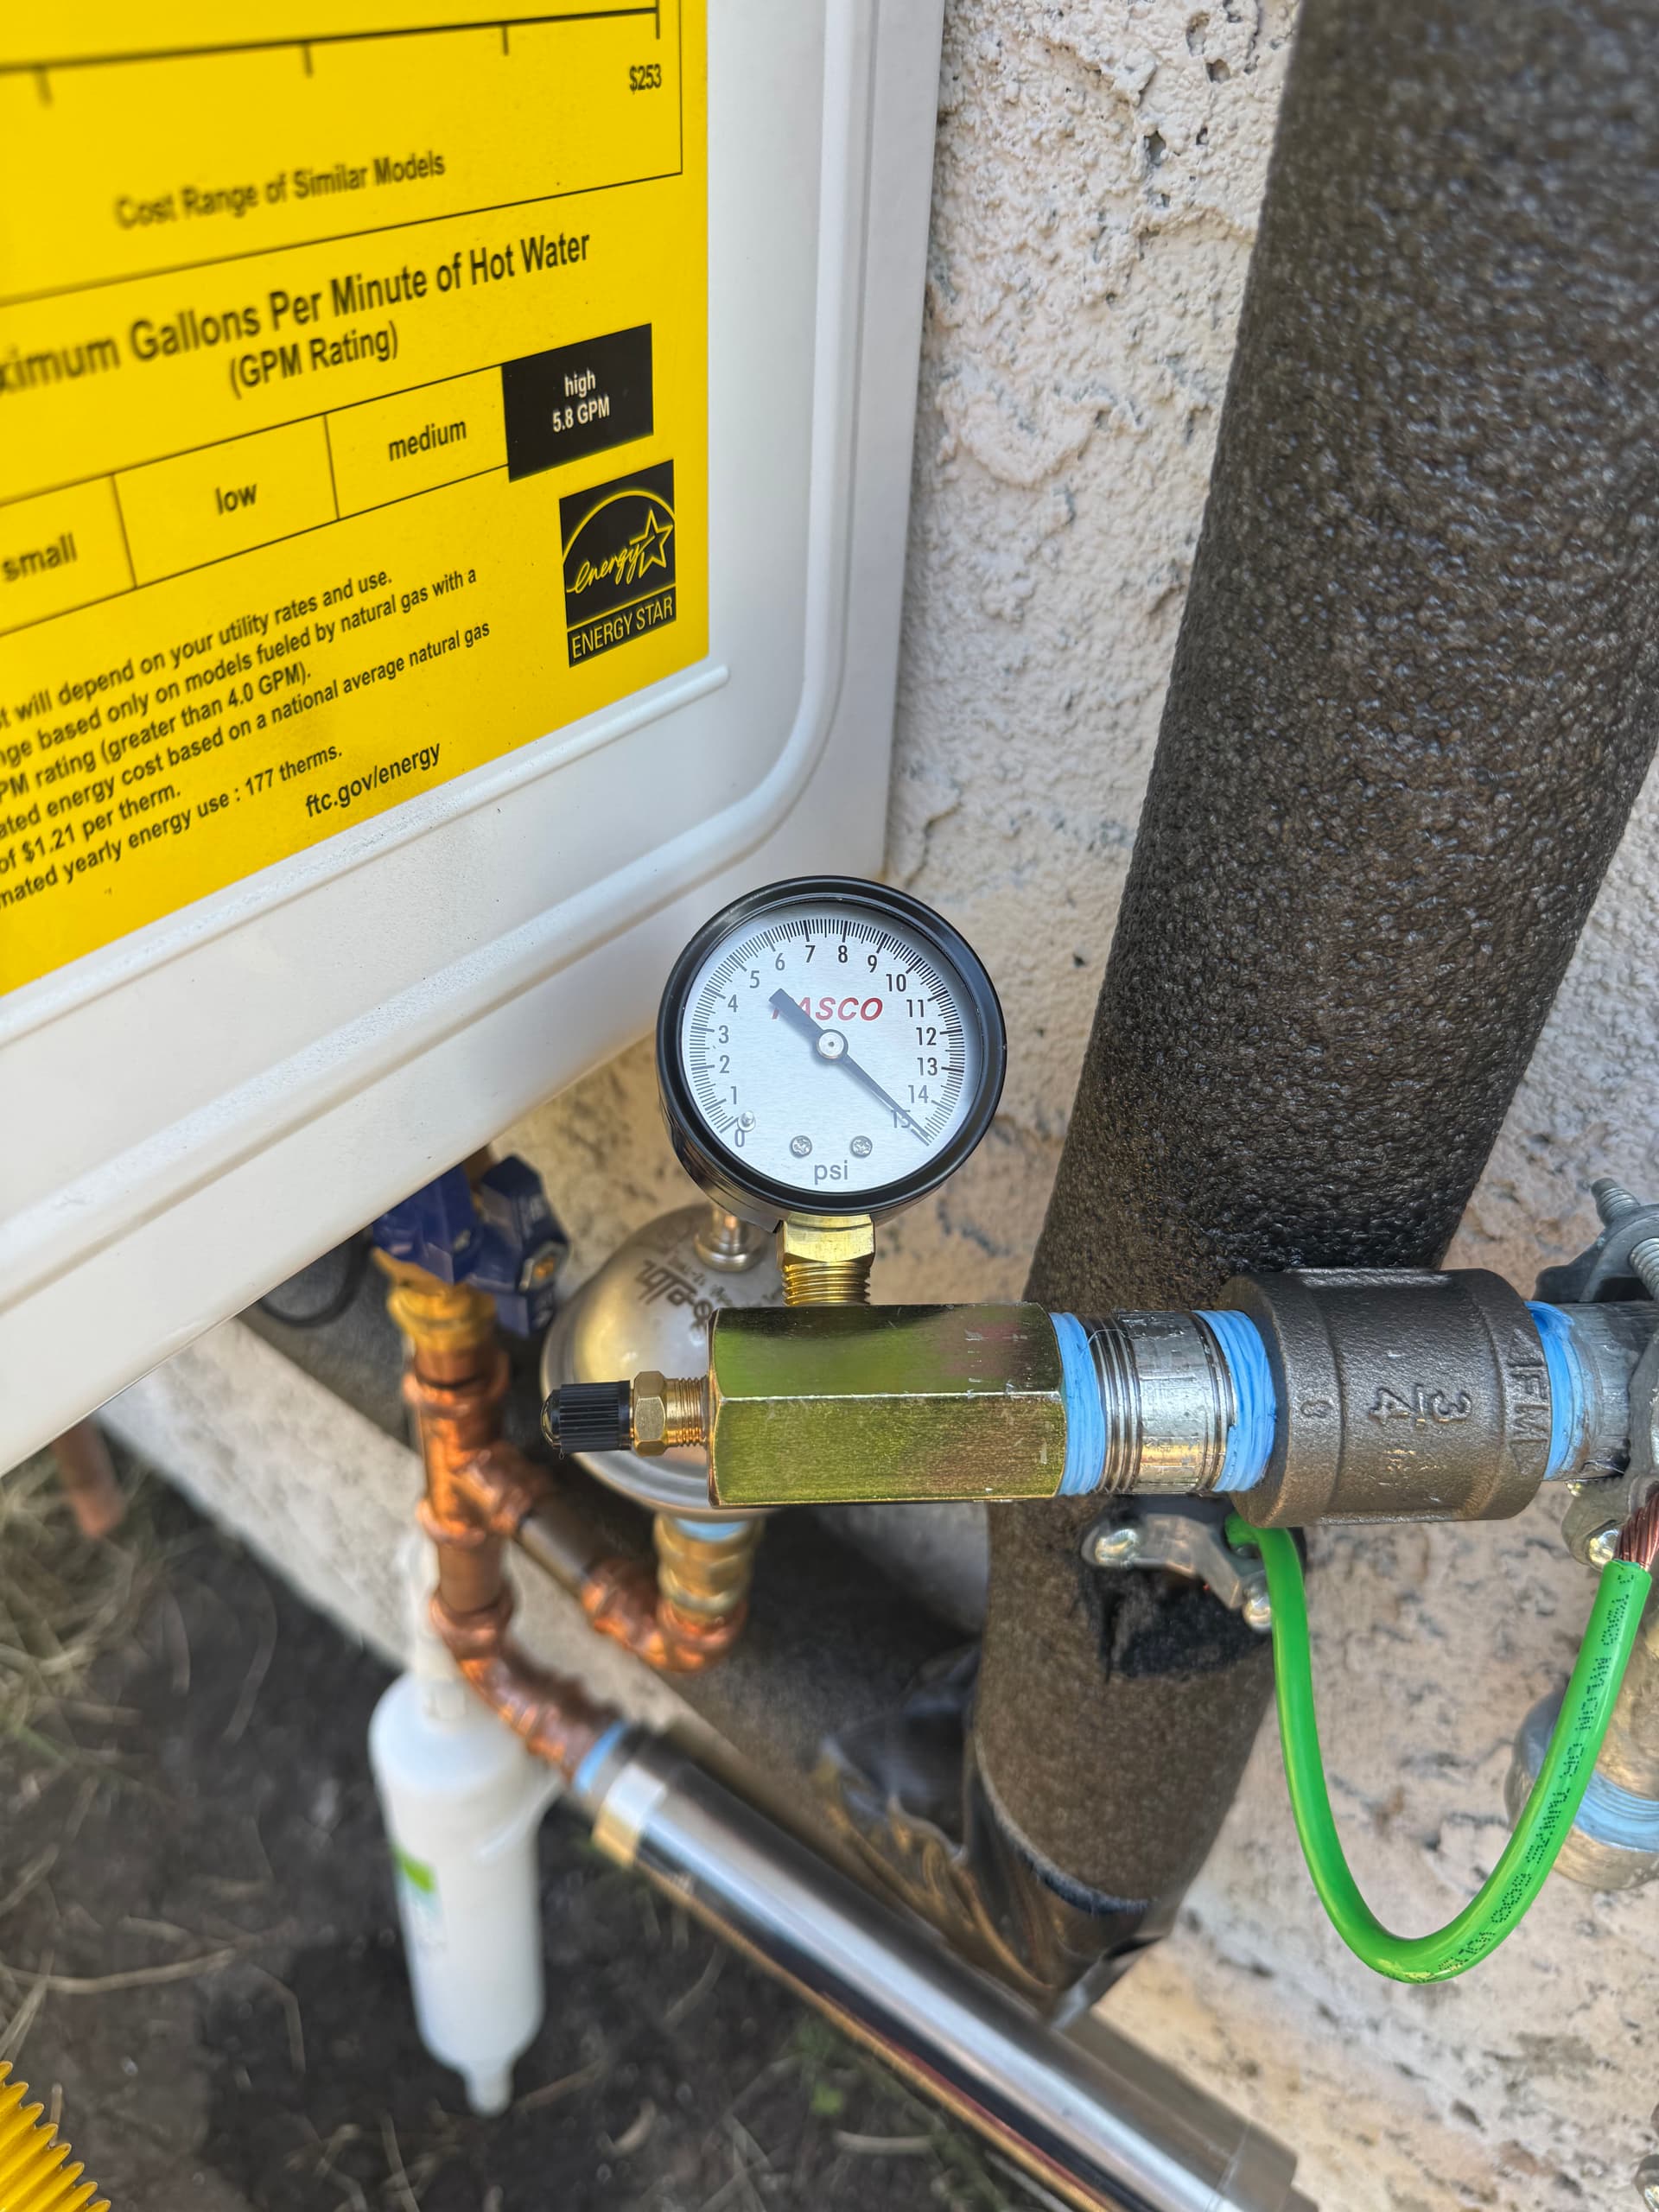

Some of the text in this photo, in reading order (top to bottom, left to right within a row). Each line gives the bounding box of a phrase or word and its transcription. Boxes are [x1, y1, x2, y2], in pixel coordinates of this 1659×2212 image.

[629, 63, 662, 95] $253
[115, 150, 446, 230] Cost Range of Similar Models
[130, 306, 260, 361] Gallons
[269, 289, 321, 331] Per
[331, 265, 427, 318] Minute
[436, 252, 461, 292] of
[470, 244, 514, 285] Hot
[520, 233, 589, 273] Water
[230, 320, 397, 400] (GPM Rating)
[564, 367, 596, 398] high
[553, 395, 610, 432] 5.8 GPM
[388, 421, 467, 461] medium
[215, 483, 257, 516] low
[3, 532, 77, 583] small
[567, 543, 643, 594] energy
[572, 596, 673, 659] ENERGY STAR
[15, 690, 53, 722] will
[58, 658, 135, 706] depend
[140, 652, 167, 675] on
[170, 633, 213, 669] your
[219, 613, 270, 646] utility
[275, 596, 318, 626] rates
[322, 578, 353, 607] and
[358, 570, 392, 594] use.
[37, 709, 102, 751] based
[107, 692, 149, 723] only
[156, 683, 181, 703] on
[185, 652, 252, 693] models
[257, 626, 311, 665] fueled
[315, 620, 335, 643] by
[340, 594, 397, 632] natural
[401, 586, 429, 613] gas
[432, 570, 463, 597] with
[467, 569, 477, 583] a
[35, 750, 97, 789] rating
[101, 716, 175, 765] (greater
[181, 698, 223, 728] than
[228, 682, 253, 708] 4.0
[258, 661, 311, 696] GPM).
[47, 775, 115, 820] energy
[121, 753, 163, 786] cost
[168, 726, 224, 767] based
[228, 719, 252, 741] on
[257, 714, 266, 729] a
[271, 679, 339, 724] national
[343, 657, 405, 694] average
[409, 630, 461, 667] natural
[464, 622, 491, 648] gas
[305, 742, 441, 817] ftc.gov/energy
[0, 784, 181, 874] of $1.21 per therm.
[63, 840, 122, 882] yearly
[129, 809, 191, 849] energy
[197, 793, 229, 818] use
[245, 768, 274, 796] 177
[279, 745, 342, 782] therms.
[775, 952, 785, 971] 6
[804, 944, 817, 963] 7
[838, 944, 849, 963] 8
[867, 954, 878, 973] 9
[749, 970, 760, 989] 5
[886, 973, 907, 992] 10
[728, 995, 738, 1014] 4
[906, 999, 925, 1018] 11
[718, 1026, 728, 1044] 3
[916, 1027, 937, 1046] 12
[719, 1055, 730, 1074] 2
[917, 1057, 938, 1076] 13
[730, 1085, 737, 1104] 1
[908, 1084, 929, 1103] 14
[734, 1127, 746, 1147] 0
[814, 1160, 849, 1185] psi
